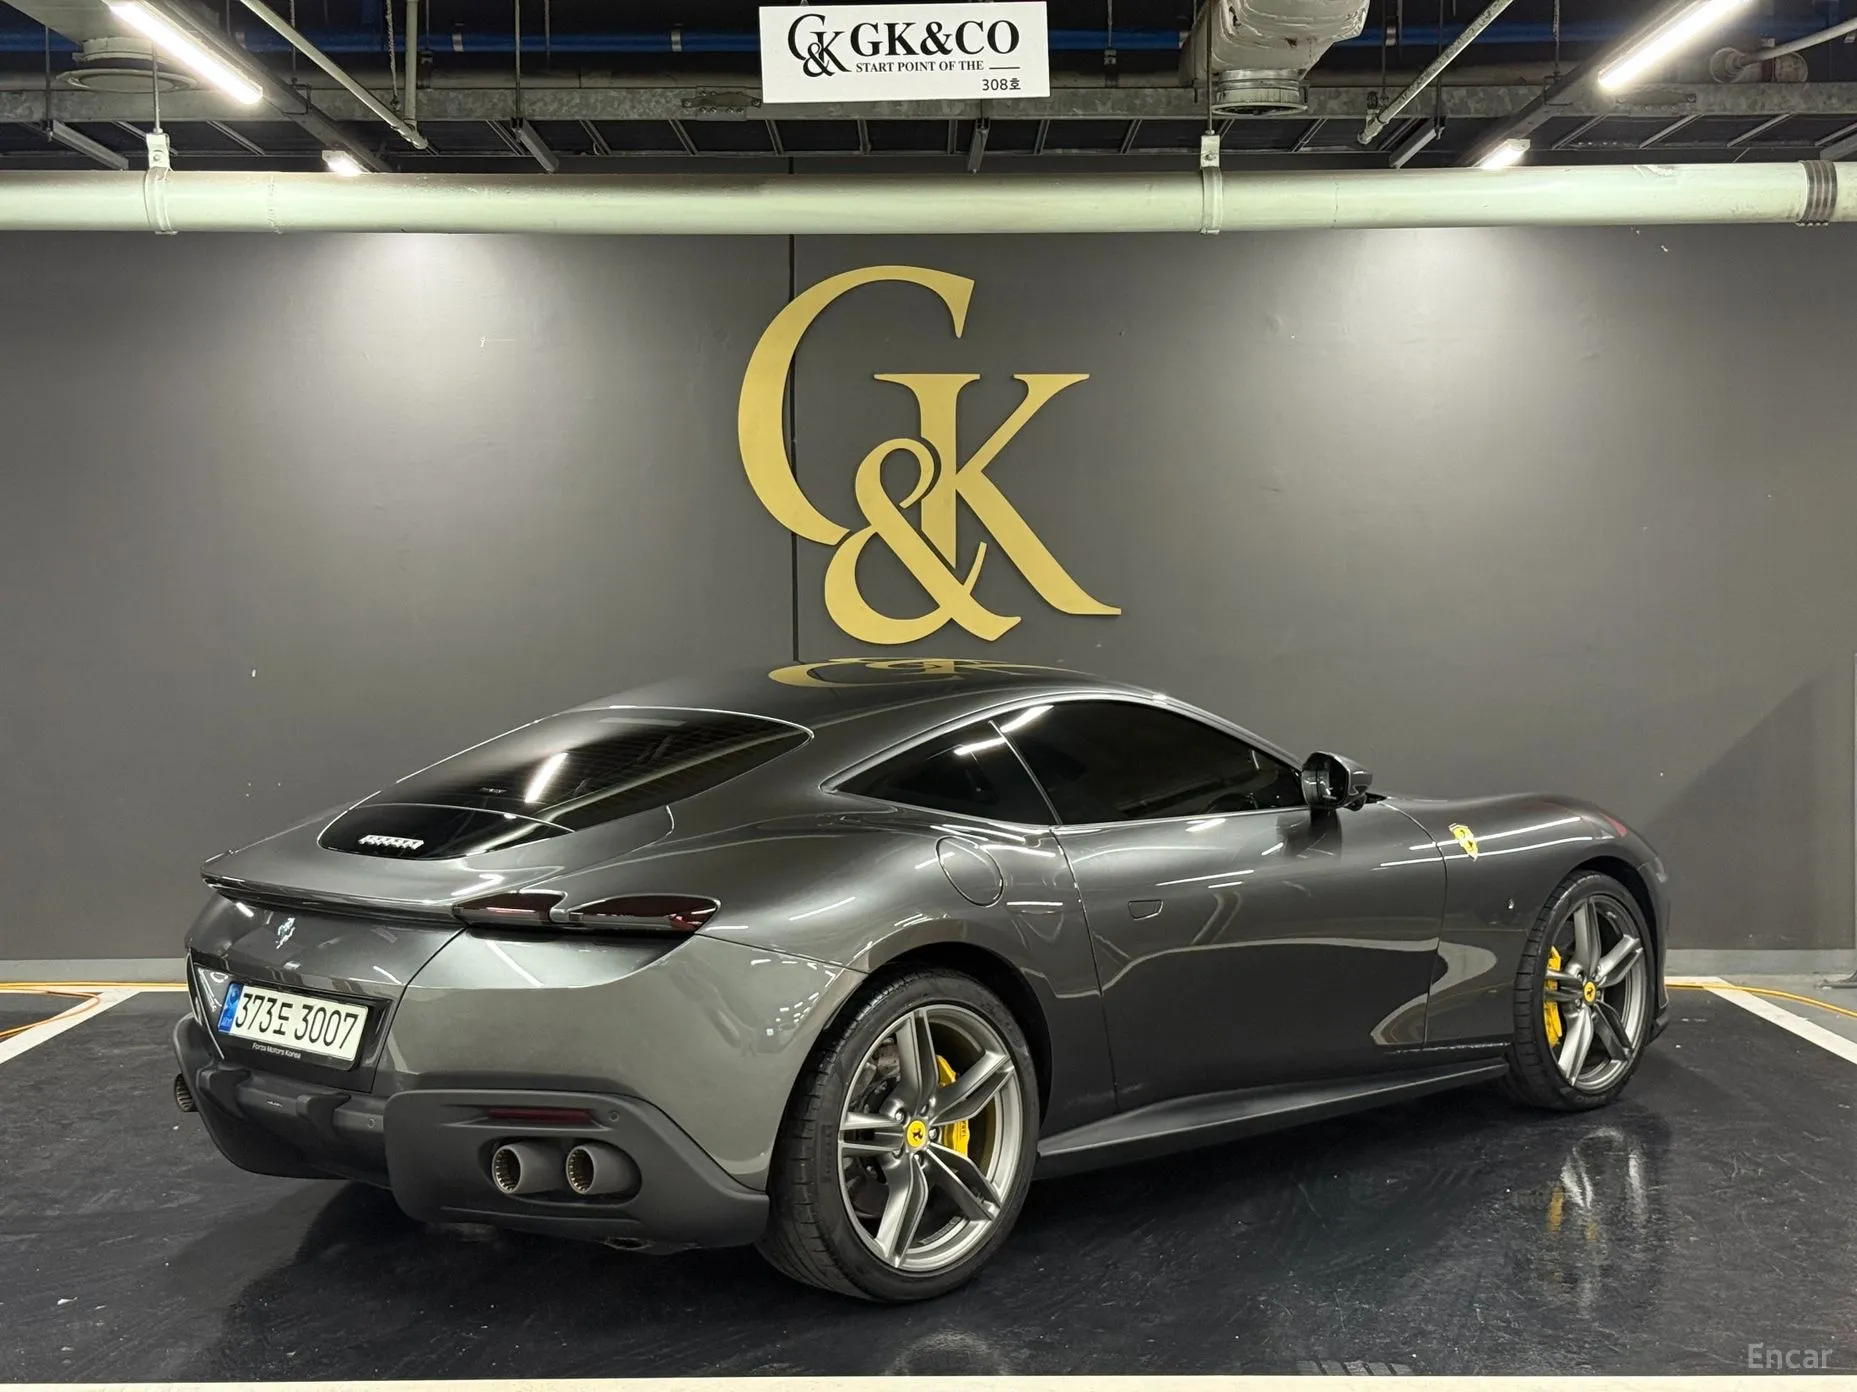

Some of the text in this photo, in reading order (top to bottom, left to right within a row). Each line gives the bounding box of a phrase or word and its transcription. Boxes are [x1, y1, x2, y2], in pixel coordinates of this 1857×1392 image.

[850, 19, 1020, 56] GK&CO
[856, 60, 984, 73] START POINT OF THE
[982, 77, 1021, 91] 308호
[235, 992, 359, 1050] 373도 3007
